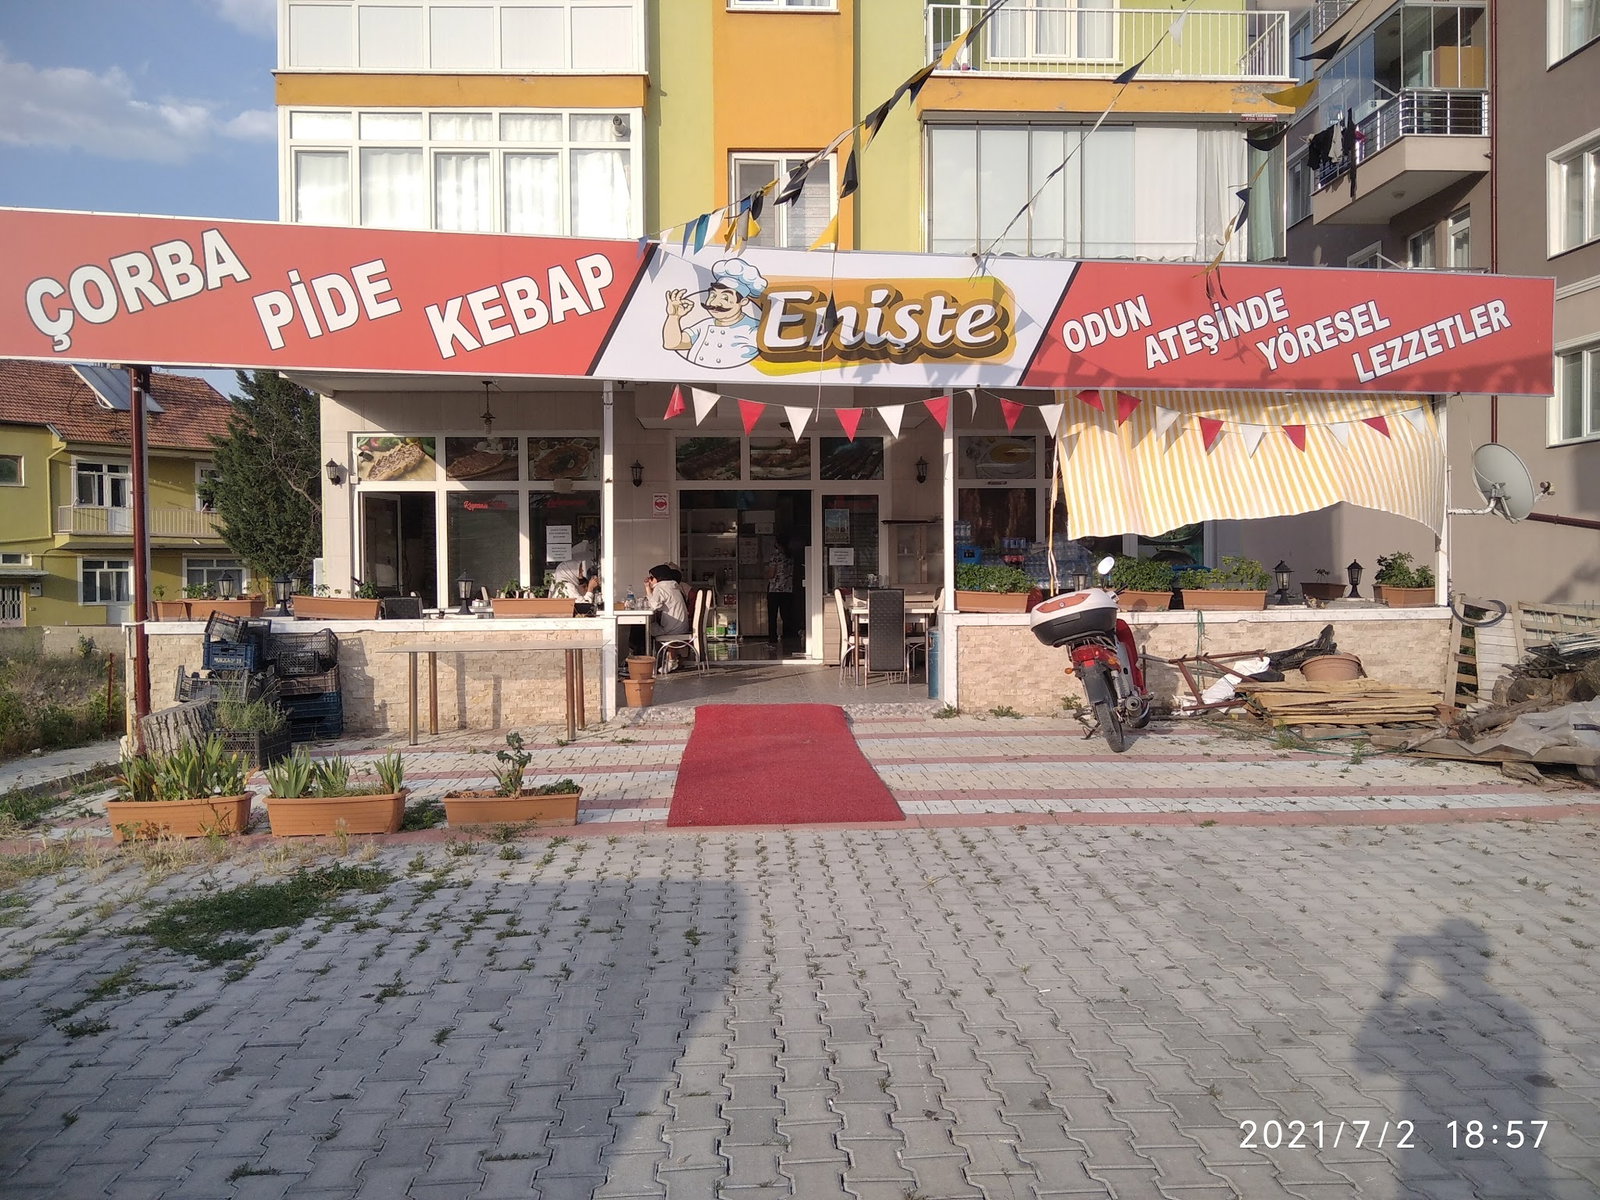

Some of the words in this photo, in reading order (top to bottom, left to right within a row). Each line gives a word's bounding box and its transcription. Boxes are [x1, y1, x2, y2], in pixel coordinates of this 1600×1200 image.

[25, 229, 250, 352] ÇORBA
[253, 258, 402, 350] PİDE
[425, 254, 613, 359] KEBAP
[763, 288, 997, 352] Enişte
[1062, 295, 1152, 353] ODUN
[1145, 288, 1290, 369] ATEŞİNDE
[1256, 300, 1391, 370] YÖRESEL
[1352, 299, 1512, 383] LEZZETLER
